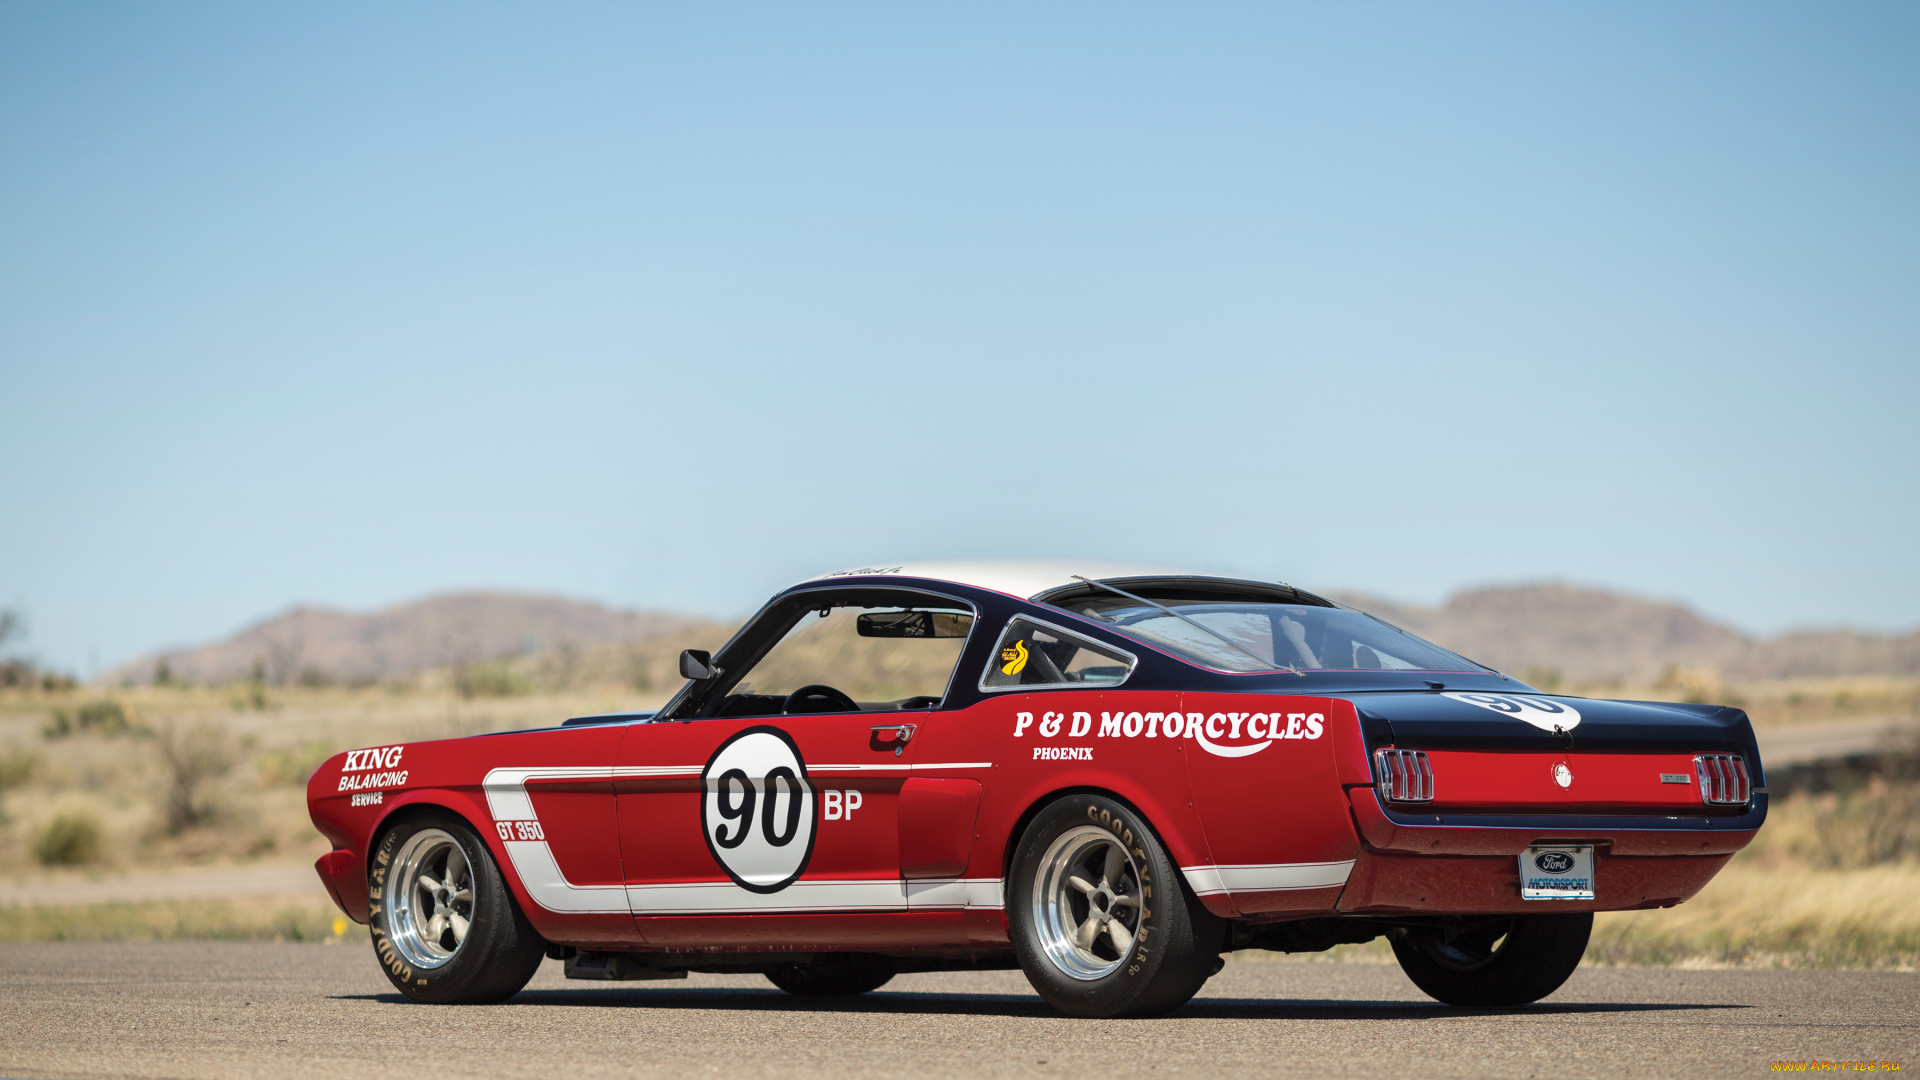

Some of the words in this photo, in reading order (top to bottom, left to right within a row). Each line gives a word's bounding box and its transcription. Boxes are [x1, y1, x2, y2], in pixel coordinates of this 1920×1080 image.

[1013, 711, 1034, 737] P
[1039, 711, 1064, 737] &
[1068, 711, 1092, 737] D
[1097, 711, 1325, 757] MOTORCYCLES
[341, 746, 404, 772] KING
[1032, 747, 1093, 760] PHOENIX
[338, 770, 408, 791] BALANCING
[351, 791, 383, 807] SERVICE
[715, 766, 803, 849] 90
[824, 789, 863, 821] BP
[496, 821, 515, 840] GT
[515, 821, 545, 840] 350
[1542, 854, 1567, 870] Ford
[1528, 878, 1588, 890] MOTORSPORT
